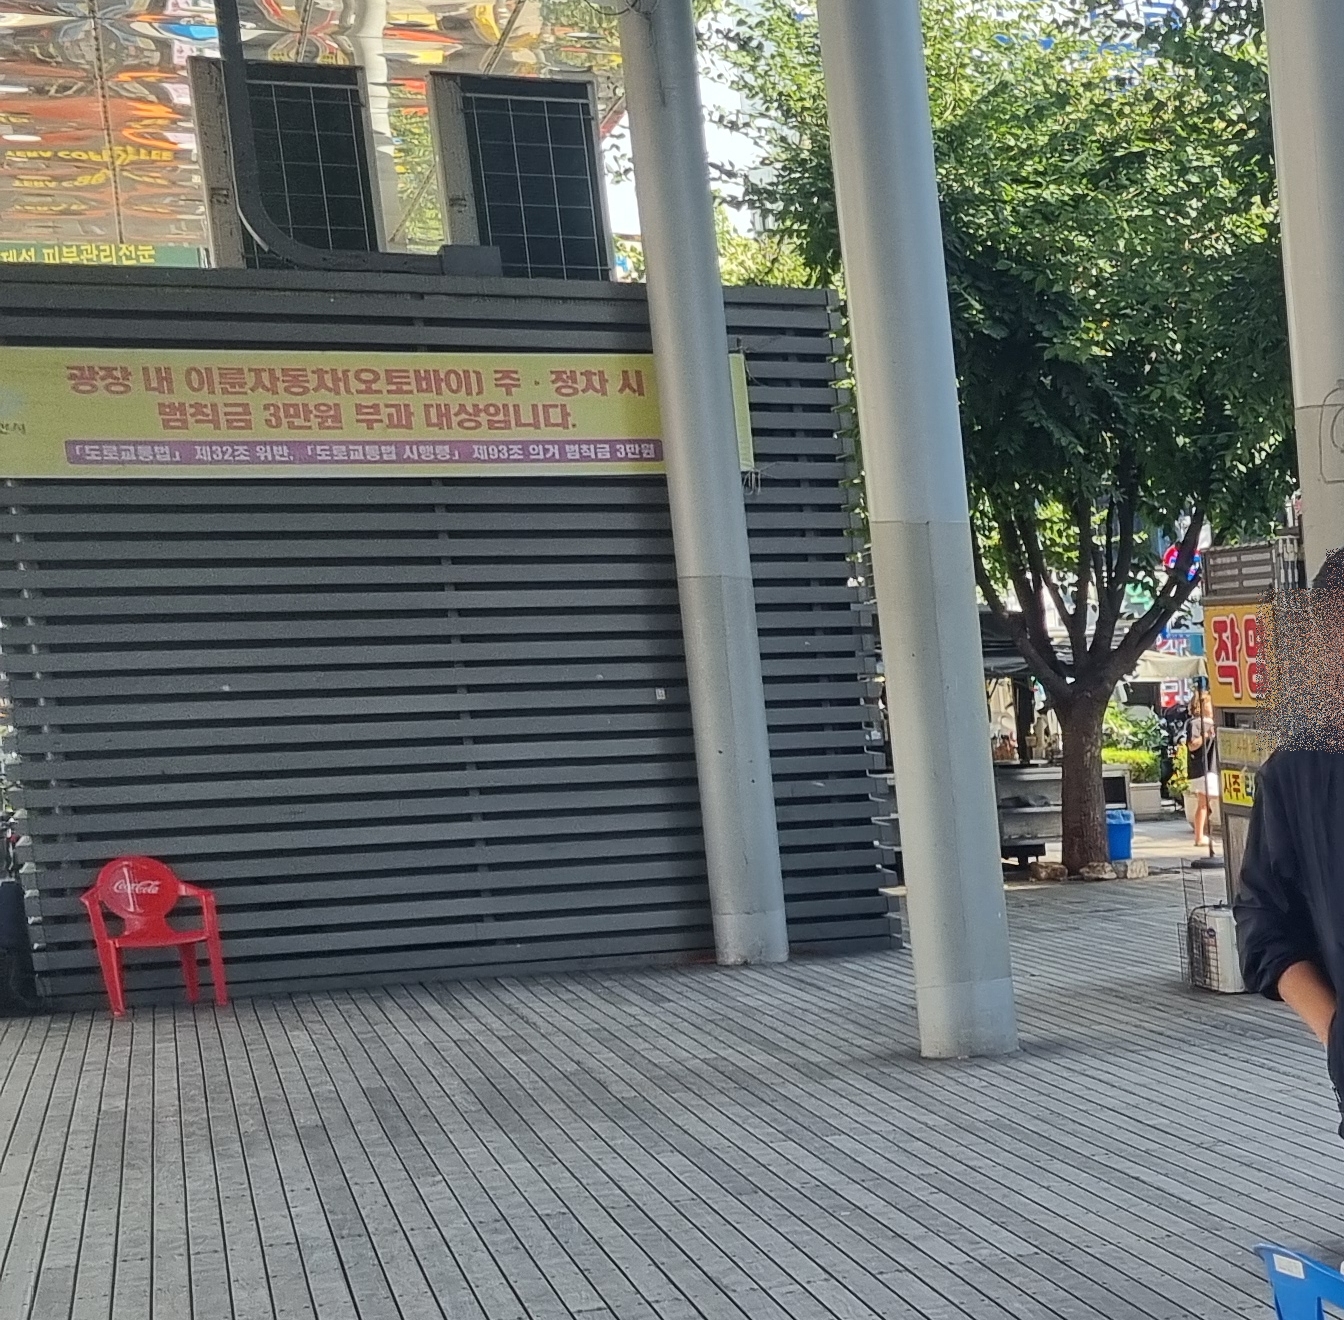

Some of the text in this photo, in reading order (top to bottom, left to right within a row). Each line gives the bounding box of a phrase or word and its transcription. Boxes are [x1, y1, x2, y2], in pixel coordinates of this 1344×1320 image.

[66, 365, 648, 398] 광장 내 이륜자동차(오토바이) 주 정차 시
[157, 401, 577, 431] 범칙금 3만원 부과 대상입니다.
[195, 444, 250, 463] 제32조
[472, 443, 524, 461] 제93조
[529, 443, 560, 461] 의거
[565, 443, 611, 461] 범칙금
[616, 443, 656, 460] 3만원
